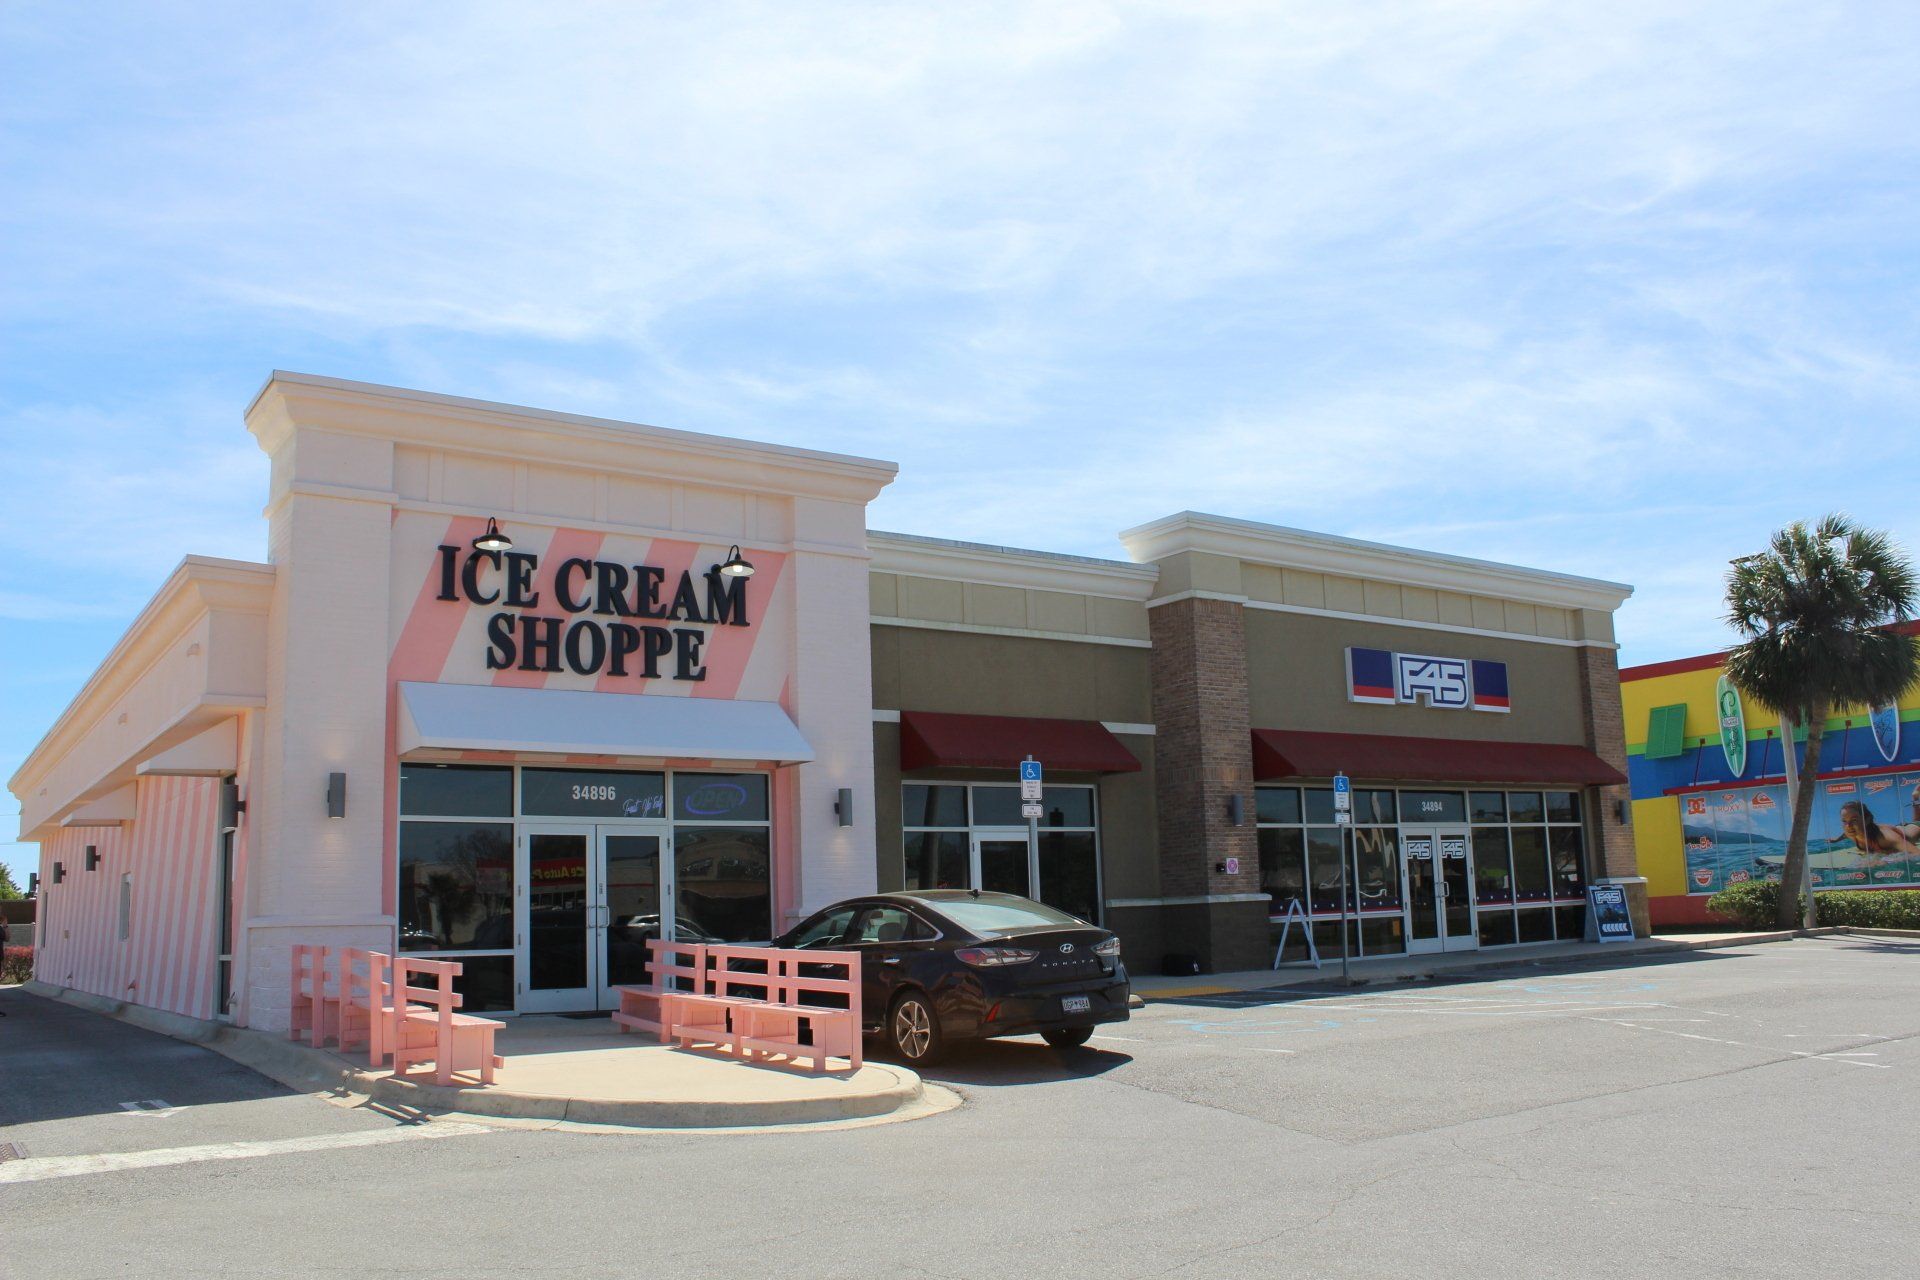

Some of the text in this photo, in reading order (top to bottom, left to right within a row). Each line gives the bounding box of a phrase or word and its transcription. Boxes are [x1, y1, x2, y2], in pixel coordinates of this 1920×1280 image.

[436, 544, 751, 627] ICE CREAM
[486, 611, 707, 682] SHOPPE
[1399, 655, 1467, 707] F45
[572, 785, 616, 800] 34896
[1421, 801, 1443, 812] 34894
[1407, 840, 1432, 859] F45
[1441, 840, 1465, 858] F45
[1595, 890, 1622, 904] F45
[1042, 958, 1094, 968] SONATA
